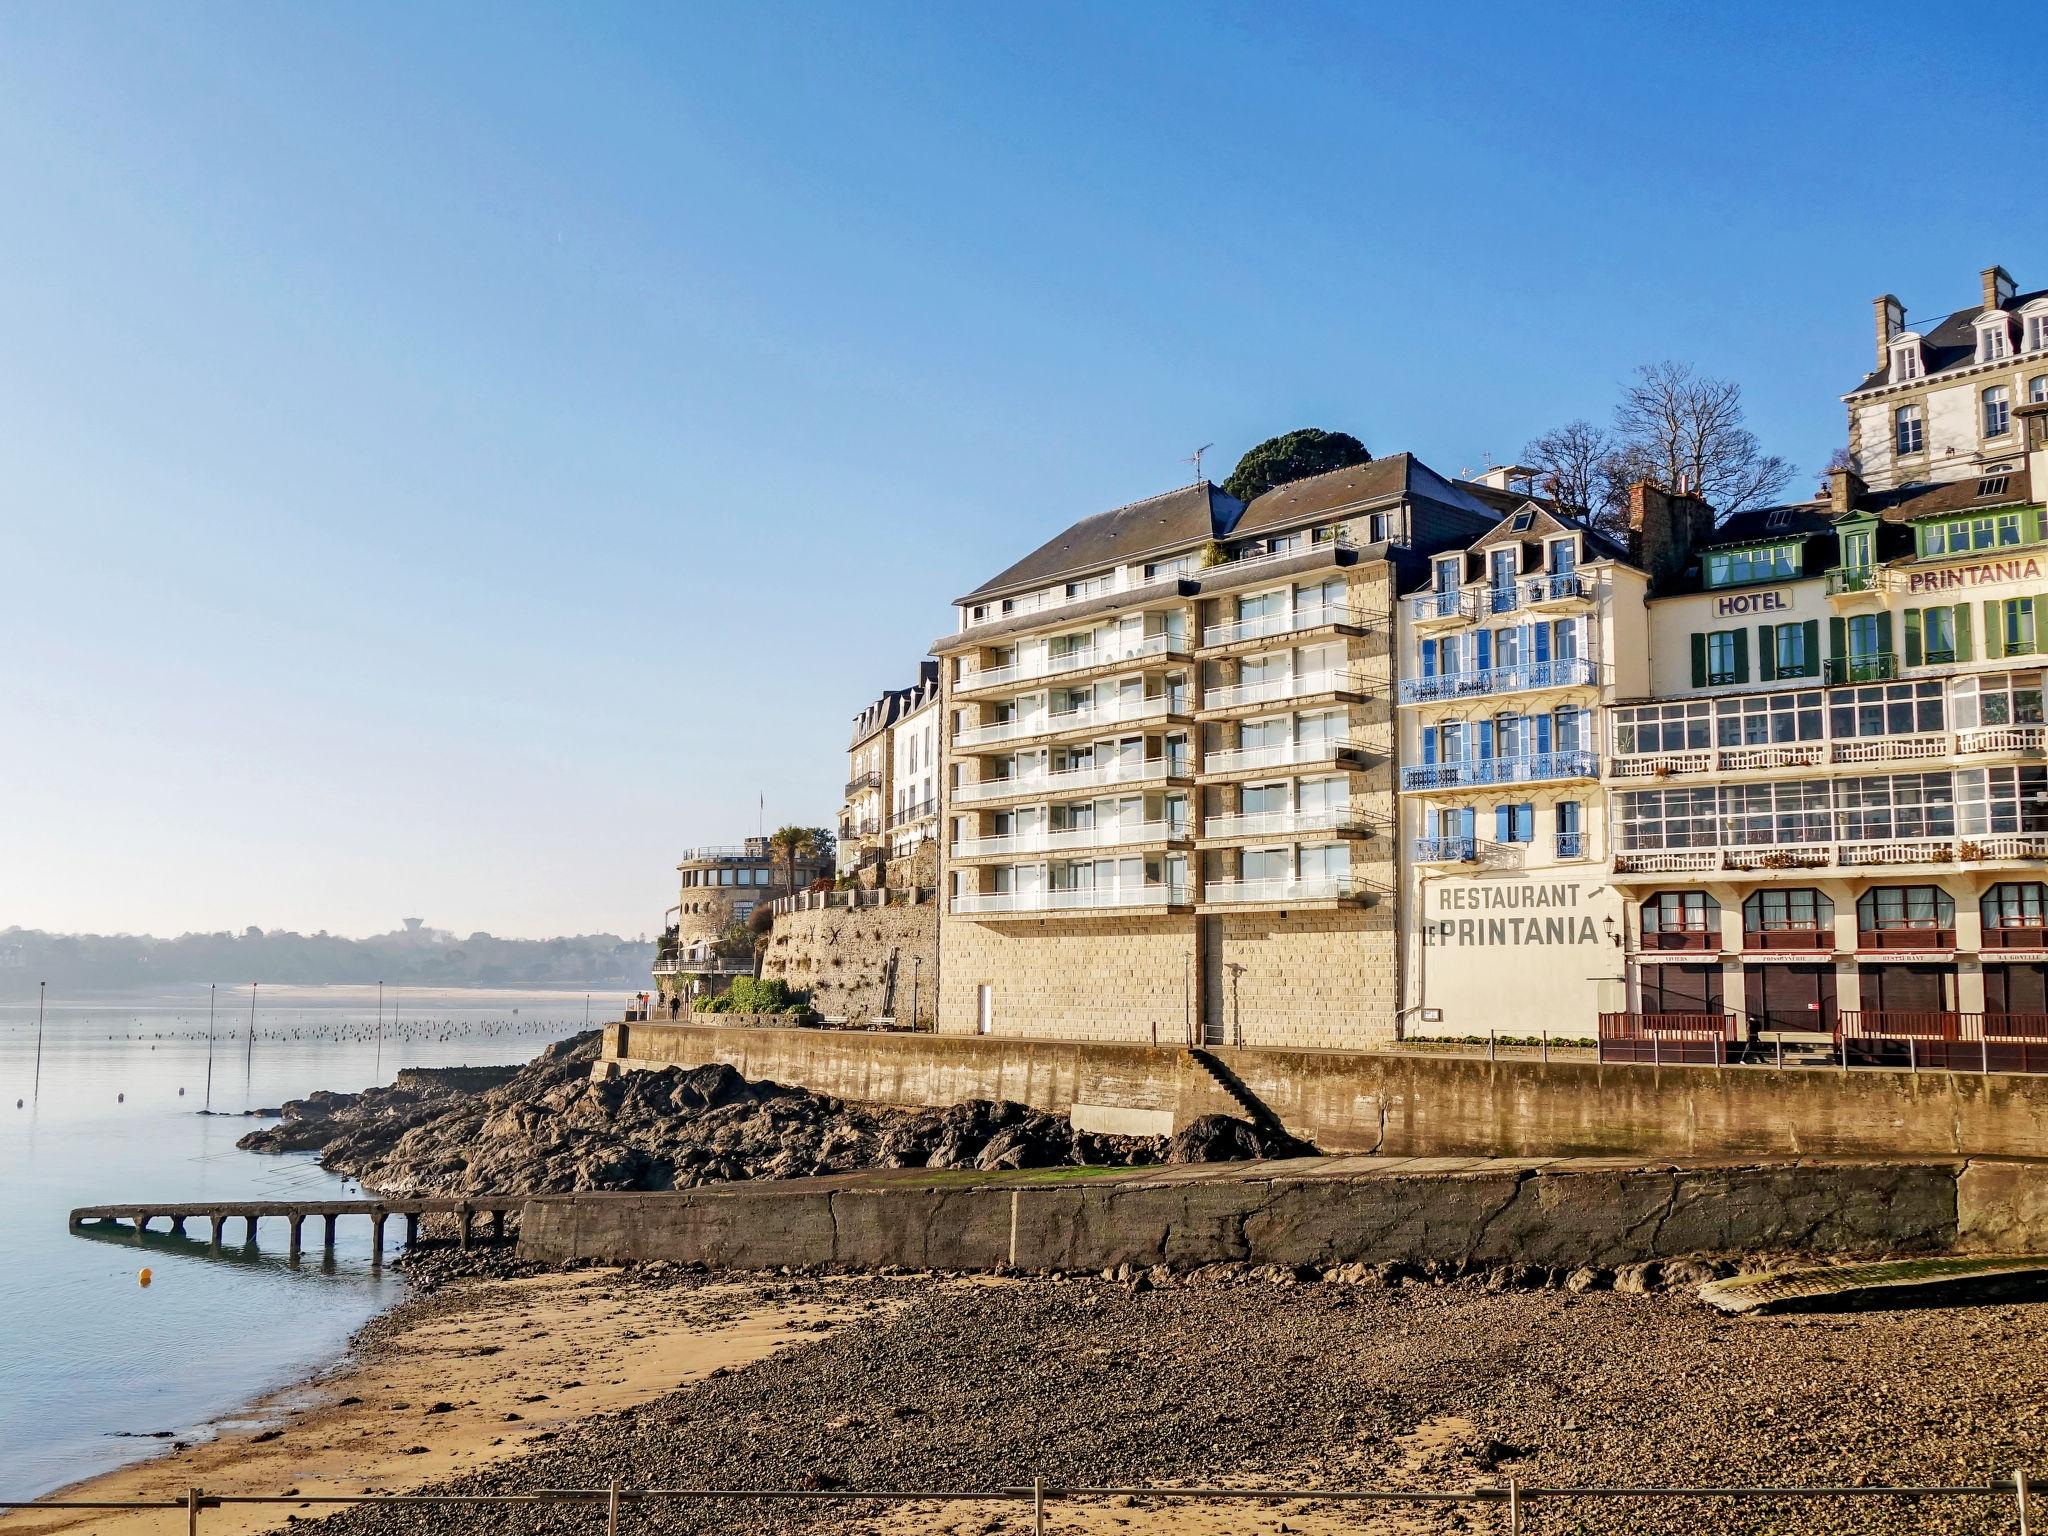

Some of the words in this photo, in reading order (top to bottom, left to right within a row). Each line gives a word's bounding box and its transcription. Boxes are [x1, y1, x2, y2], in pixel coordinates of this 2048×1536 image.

[1910, 559, 2041, 593] PRINTANIA
[1719, 592, 1787, 615] HOTEL
[1440, 884, 1580, 910] RESTAURANT
[1423, 926, 1436, 946] LE
[1440, 916, 1599, 947] PRINTANIA
